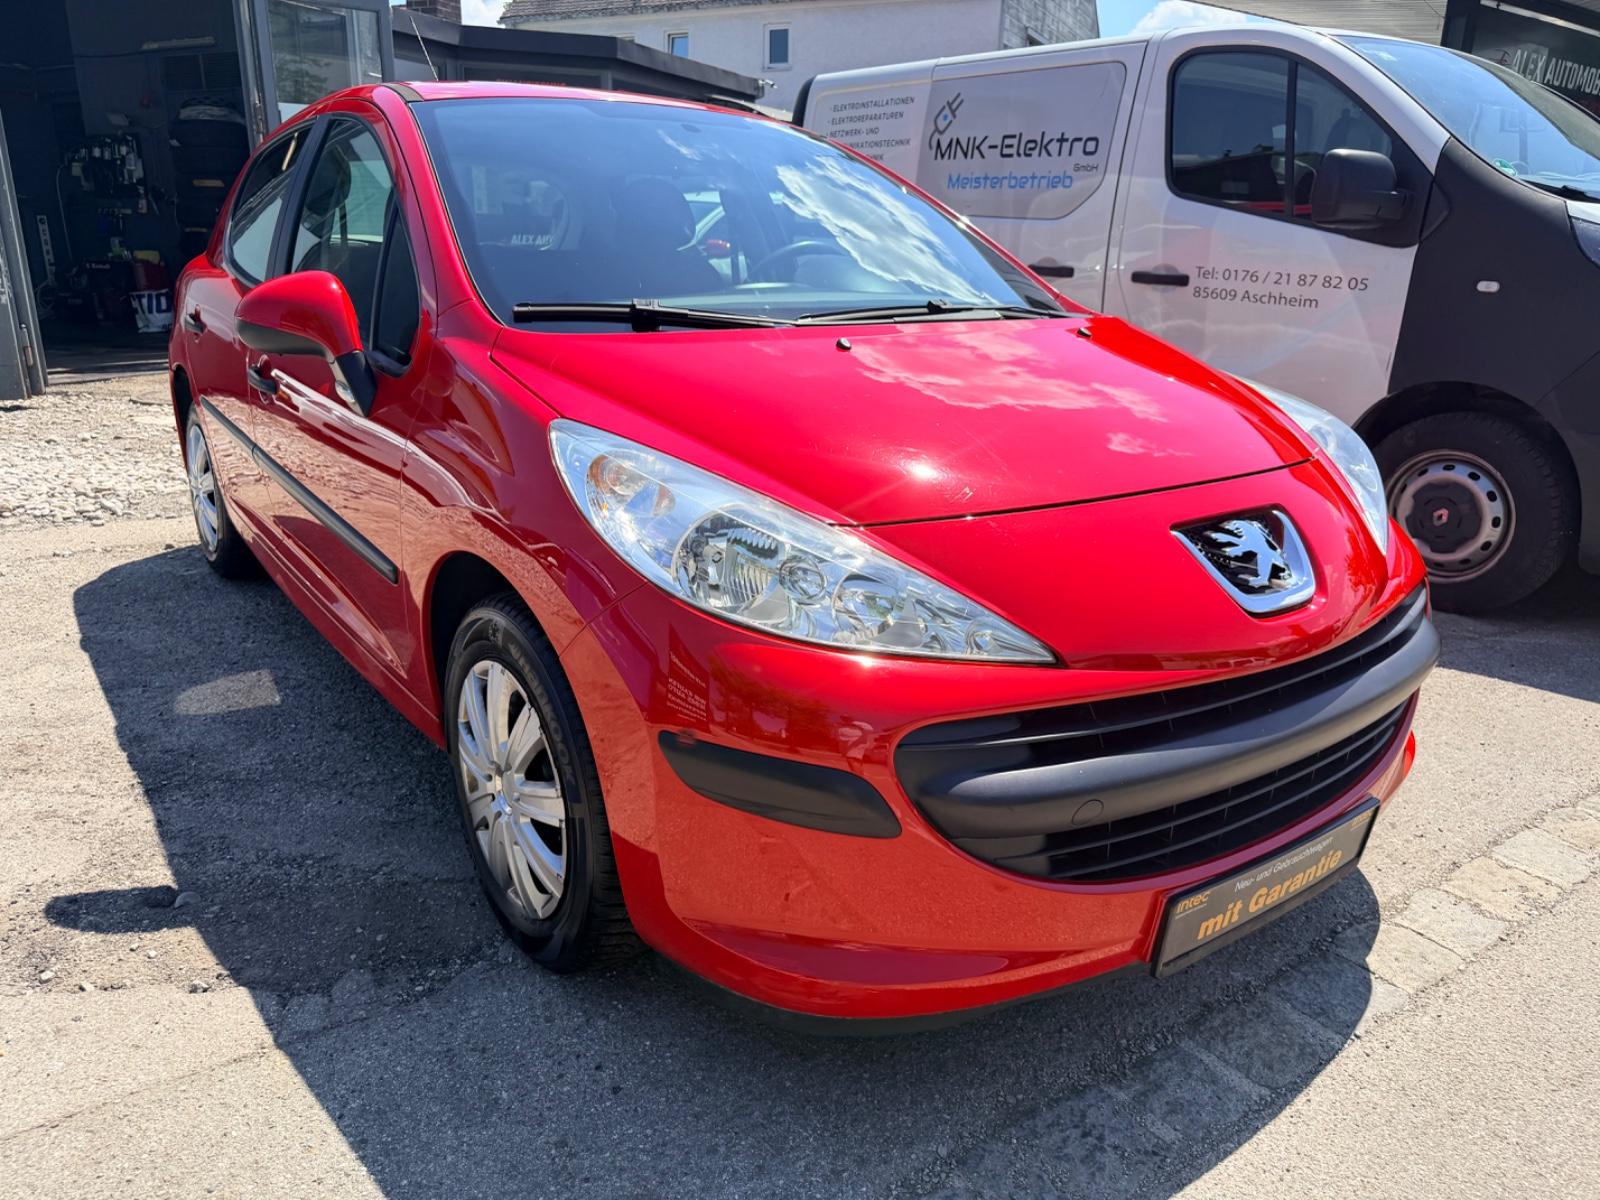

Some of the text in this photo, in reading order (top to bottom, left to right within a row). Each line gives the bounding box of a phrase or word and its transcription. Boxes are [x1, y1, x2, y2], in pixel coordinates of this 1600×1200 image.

[1544, 57, 1600, 96] AUTOMOB
[832, 96, 915, 113] ELEKTROINSTALLATIONEN
[831, 111, 904, 126] ELEKTROREPARATUREN
[934, 132, 1099, 161] MNK-Elektro
[1073, 163, 1099, 173] GmbH
[947, 171, 1074, 190] Meisterbetrieb
[1195, 265, 1219, 280] Tel:
[1222, 267, 1259, 284] 0176
[1274, 271, 1291, 285] 21
[1297, 273, 1318, 288] 87
[1322, 275, 1342, 290] 82
[1348, 277, 1369, 291] 05
[1192, 286, 1319, 309] 85609 Aschheim
[1197, 850, 1343, 940] mit Garantie
